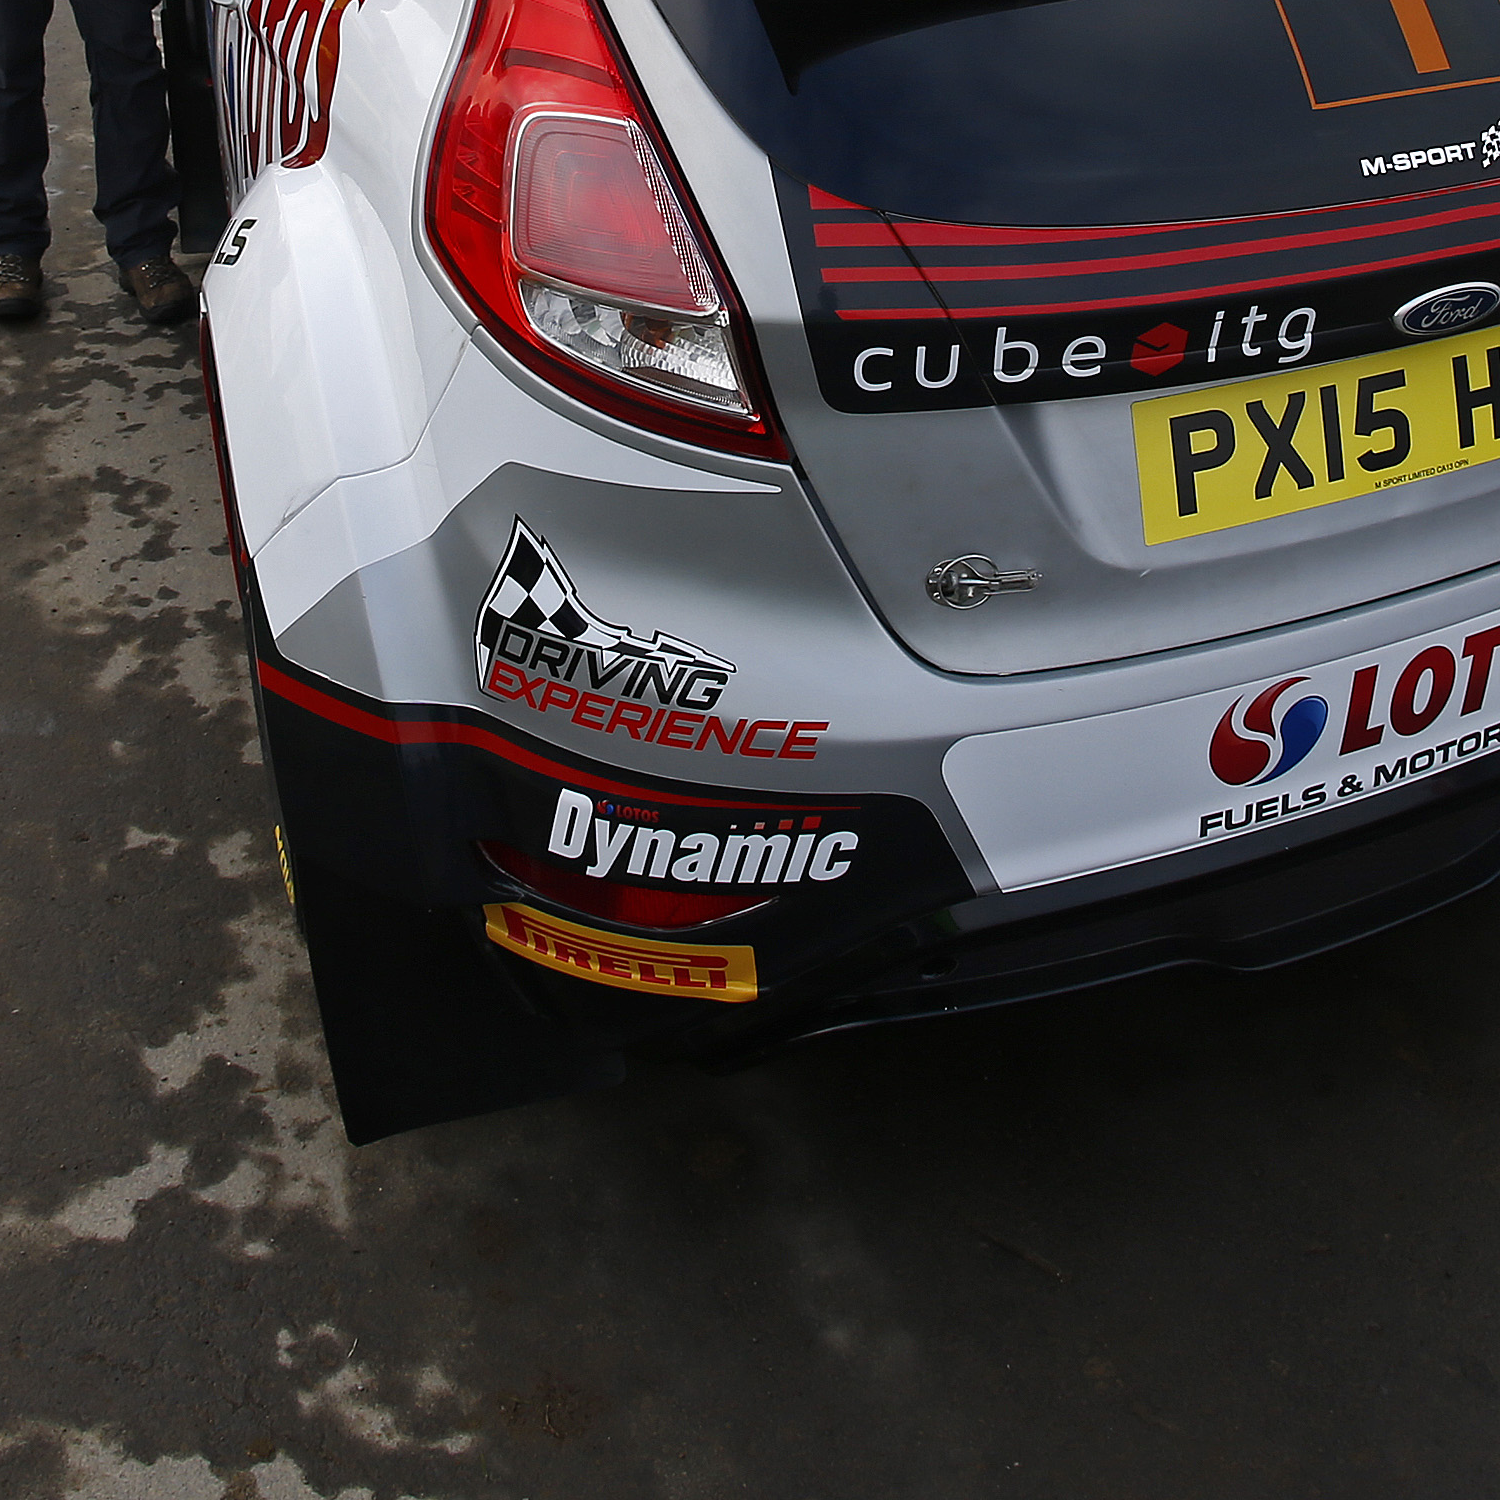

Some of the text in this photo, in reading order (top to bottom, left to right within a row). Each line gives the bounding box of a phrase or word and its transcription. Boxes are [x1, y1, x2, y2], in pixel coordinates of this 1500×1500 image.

[1360, 142, 1476, 177] M-SPORT
[853, 305, 1317, 392] cube itg
[1421, 294, 1484, 329] Ford
[1168, 366, 1412, 518] PX15
[1383, 474, 1408, 488] SPORT
[1408, 467, 1436, 481] LIMITED
[488, 659, 830, 760] EXPERIENCE
[497, 622, 729, 711] DRIVING
[548, 788, 859, 885] Dynamic
[616, 804, 660, 824] LOTOS
[1199, 782, 1326, 838] FUELS
[1340, 774, 1364, 798] &
[501, 904, 730, 990] PIRELLI
